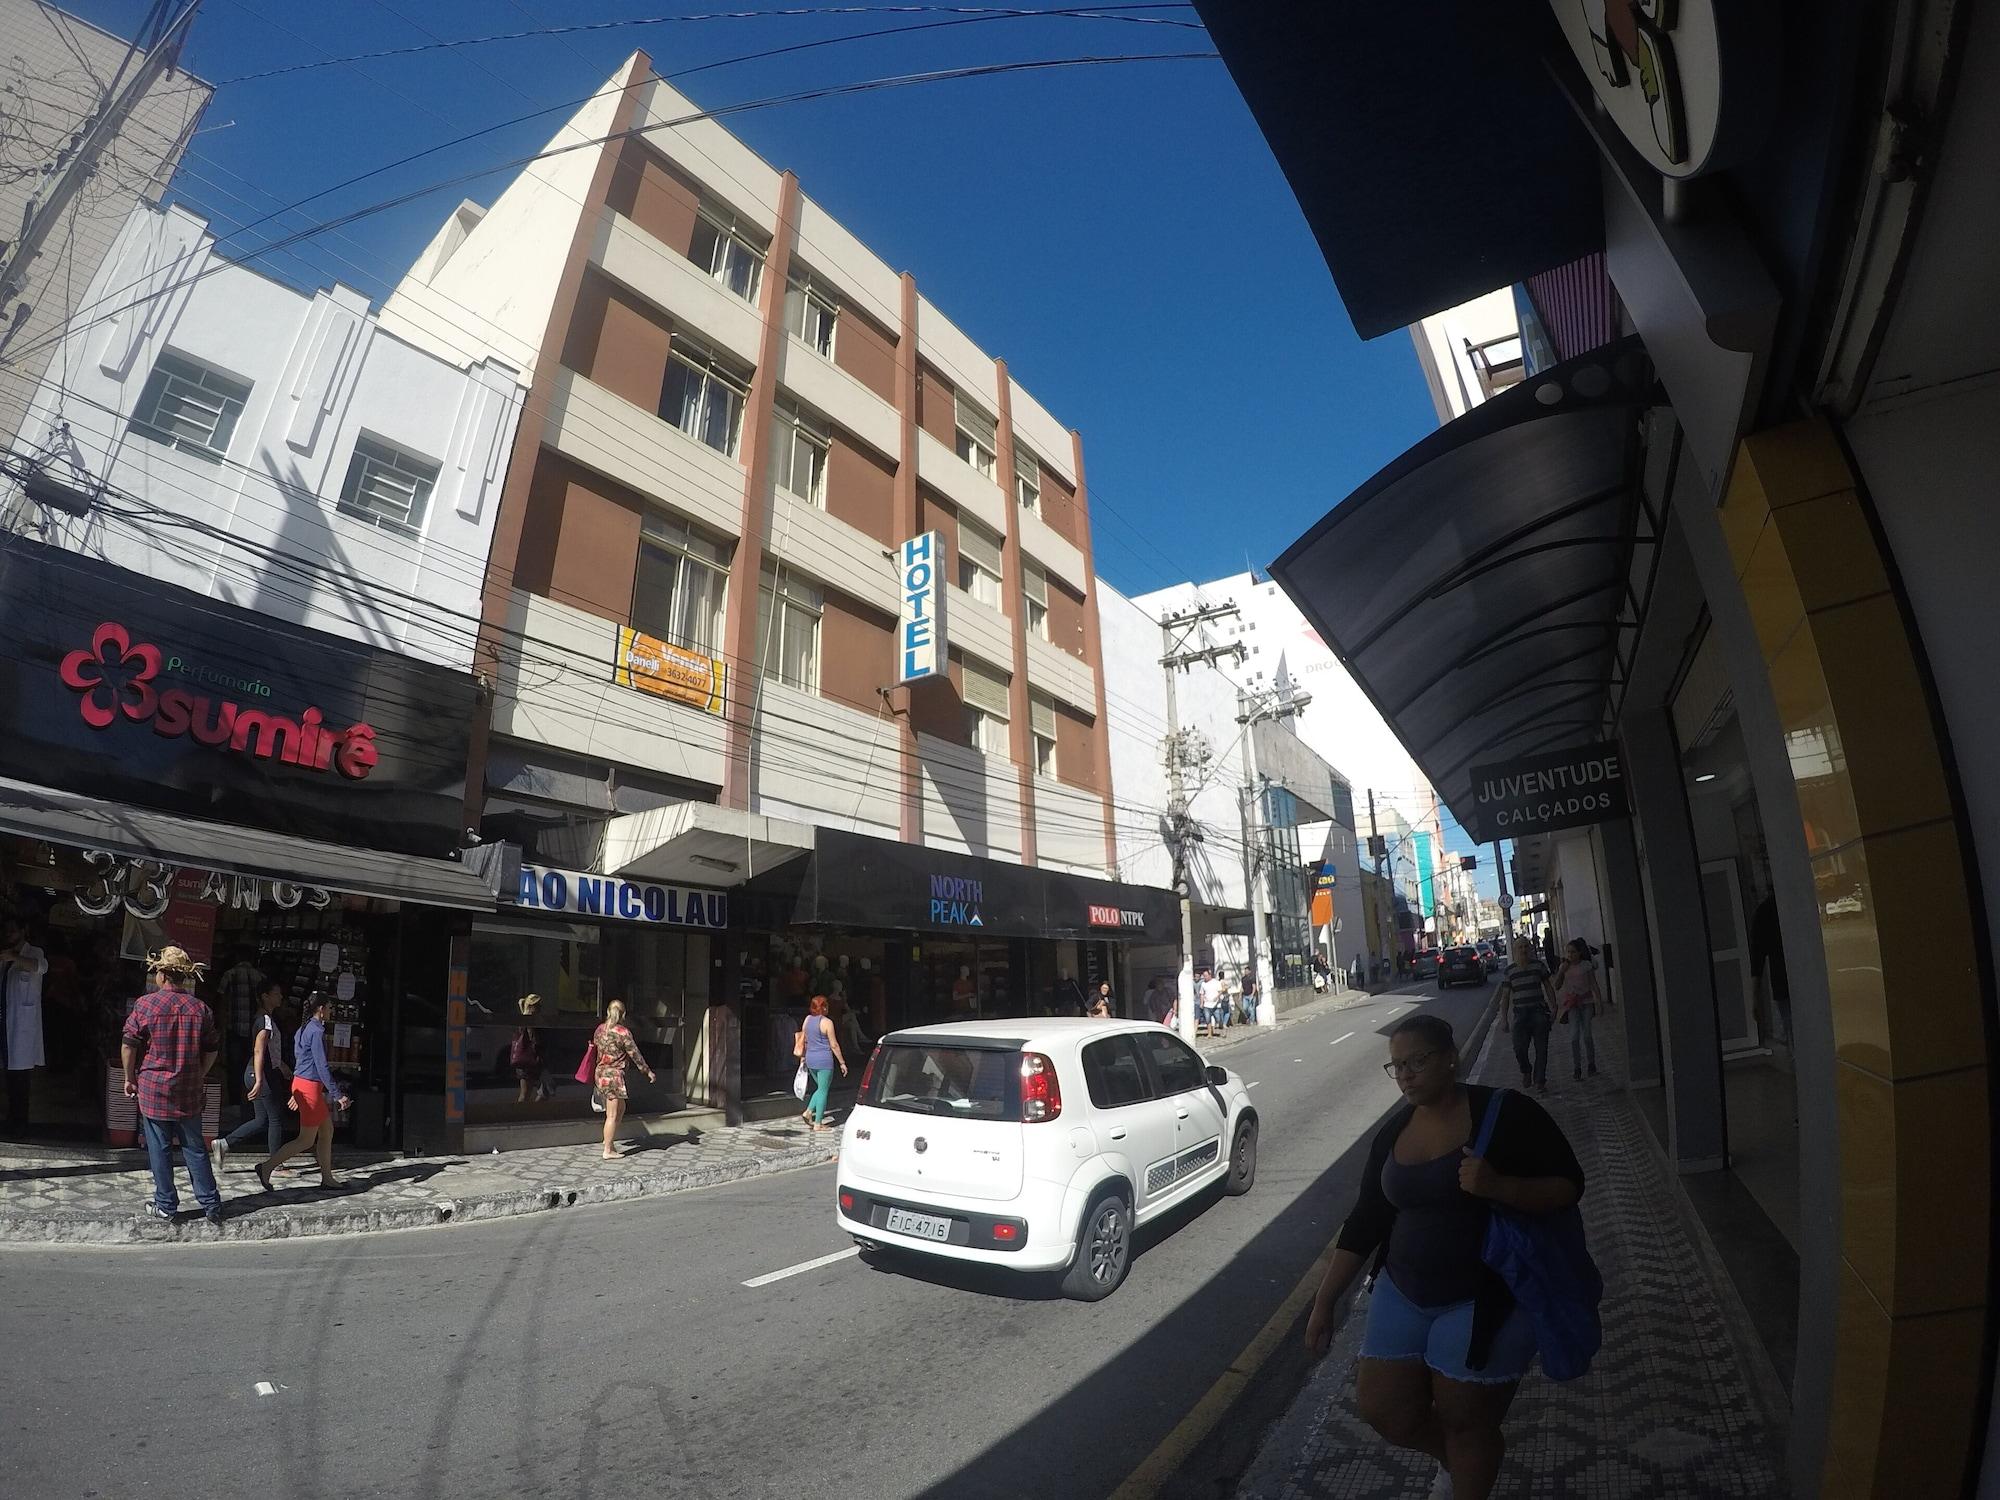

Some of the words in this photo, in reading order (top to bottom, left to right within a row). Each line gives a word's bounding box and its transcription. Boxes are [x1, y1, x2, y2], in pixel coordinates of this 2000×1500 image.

[905, 534, 931, 679] HOTEL
[168, 656, 271, 697] Perfumaria
[626, 650, 660, 672] Danelli
[155, 689, 379, 779] sumirê
[1479, 757, 1621, 803] JUVENTUDE
[1496, 792, 1611, 826] CALÇADOS
[74, 851, 174, 918] 33
[517, 865, 567, 909] ÃO
[577, 876, 727, 927] NICOLAU
[930, 874, 983, 902] NORTH
[931, 898, 968, 925] PEAK
[1090, 906, 1119, 924] POLO
[1120, 908, 1145, 927] NTPK
[447, 970, 466, 1118] HOTEL
